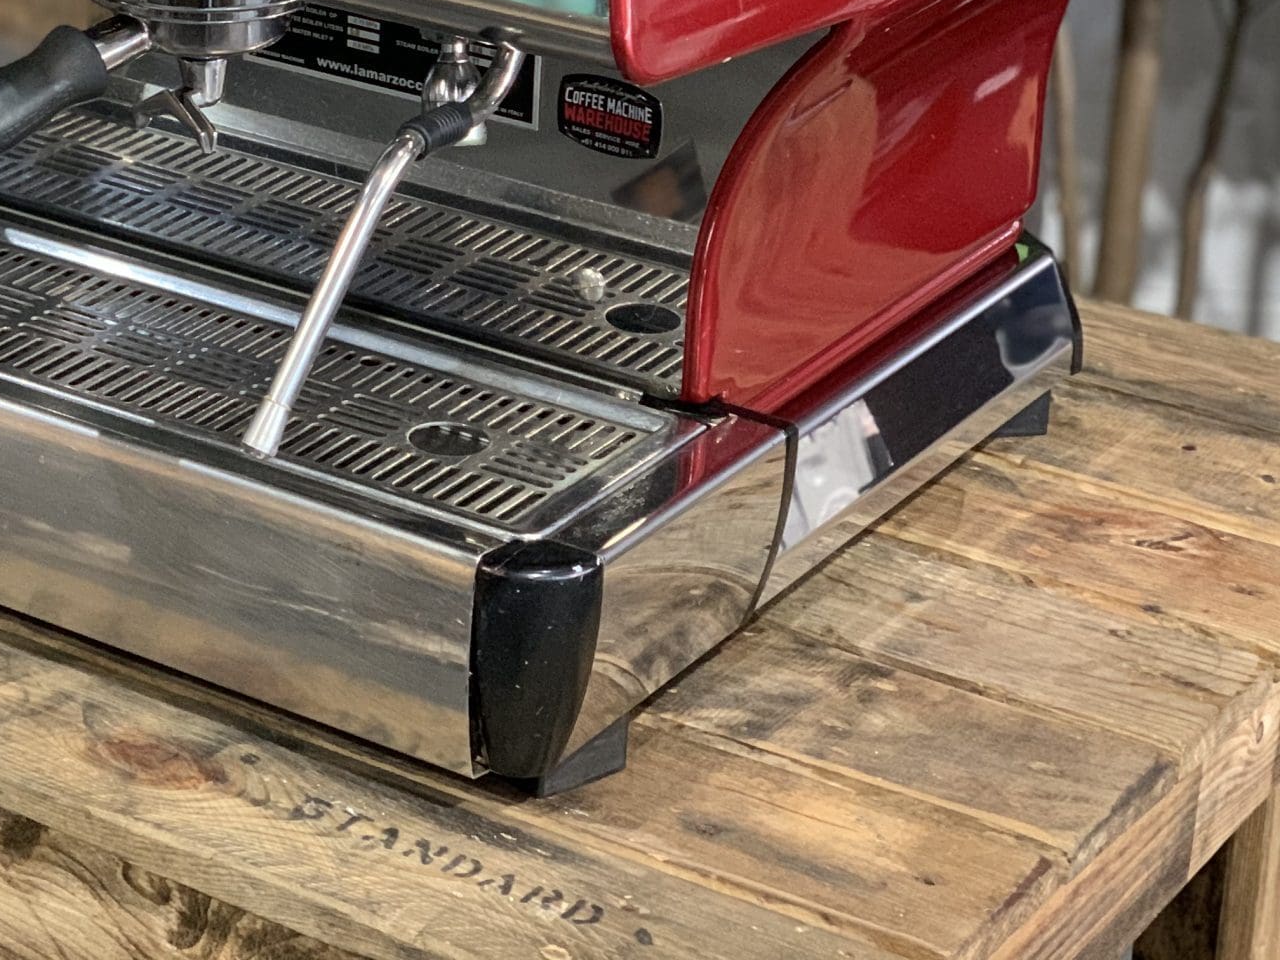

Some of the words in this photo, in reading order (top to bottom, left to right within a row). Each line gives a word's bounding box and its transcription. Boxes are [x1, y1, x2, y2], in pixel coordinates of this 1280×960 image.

[395, 39, 416, 50] STEAM
[417, 44, 439, 55] BOILER
[563, 101, 653, 142] WAREHOUSE
[564, 86, 605, 112] COFFEE
[606, 97, 653, 125] MACHINE
[571, 125, 591, 135] SALES
[595, 131, 621, 144] SERVICE
[291, 793, 605, 925] STANDARD
